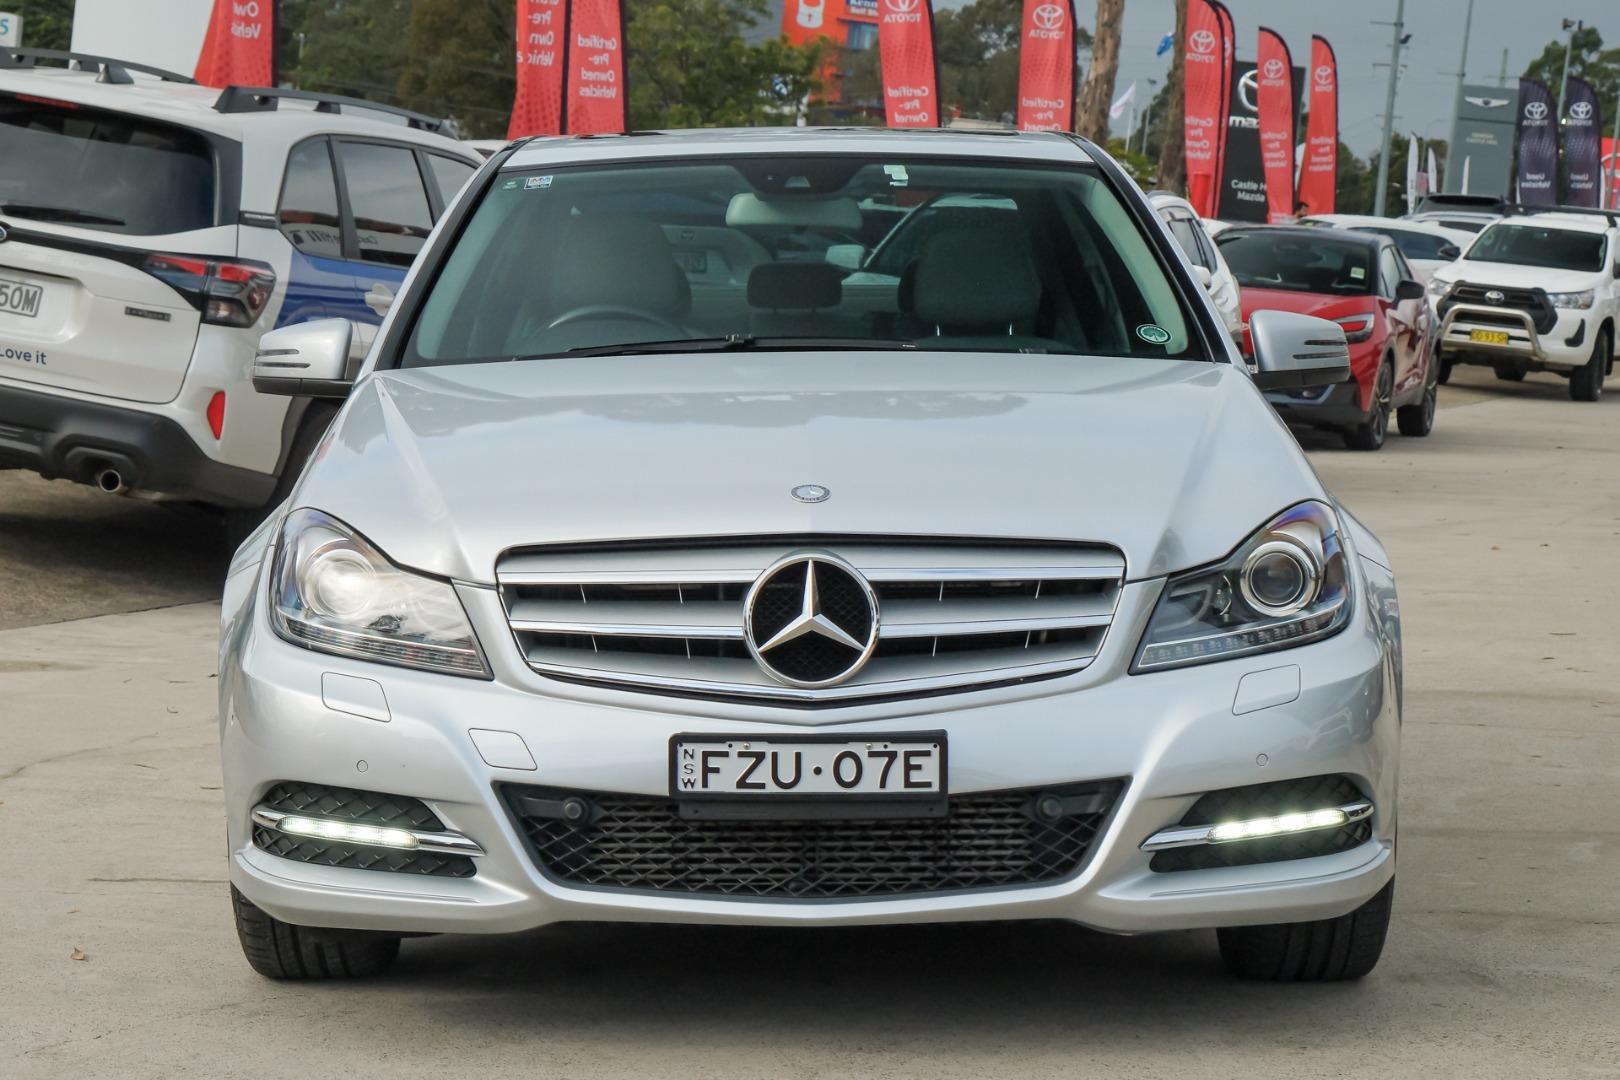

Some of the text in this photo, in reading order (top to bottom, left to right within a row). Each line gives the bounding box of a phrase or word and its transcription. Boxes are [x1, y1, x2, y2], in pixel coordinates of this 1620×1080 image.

[1231, 179, 1258, 190] Castle
[1236, 191, 1265, 202] Mazda
[35, 350, 47, 365] it
